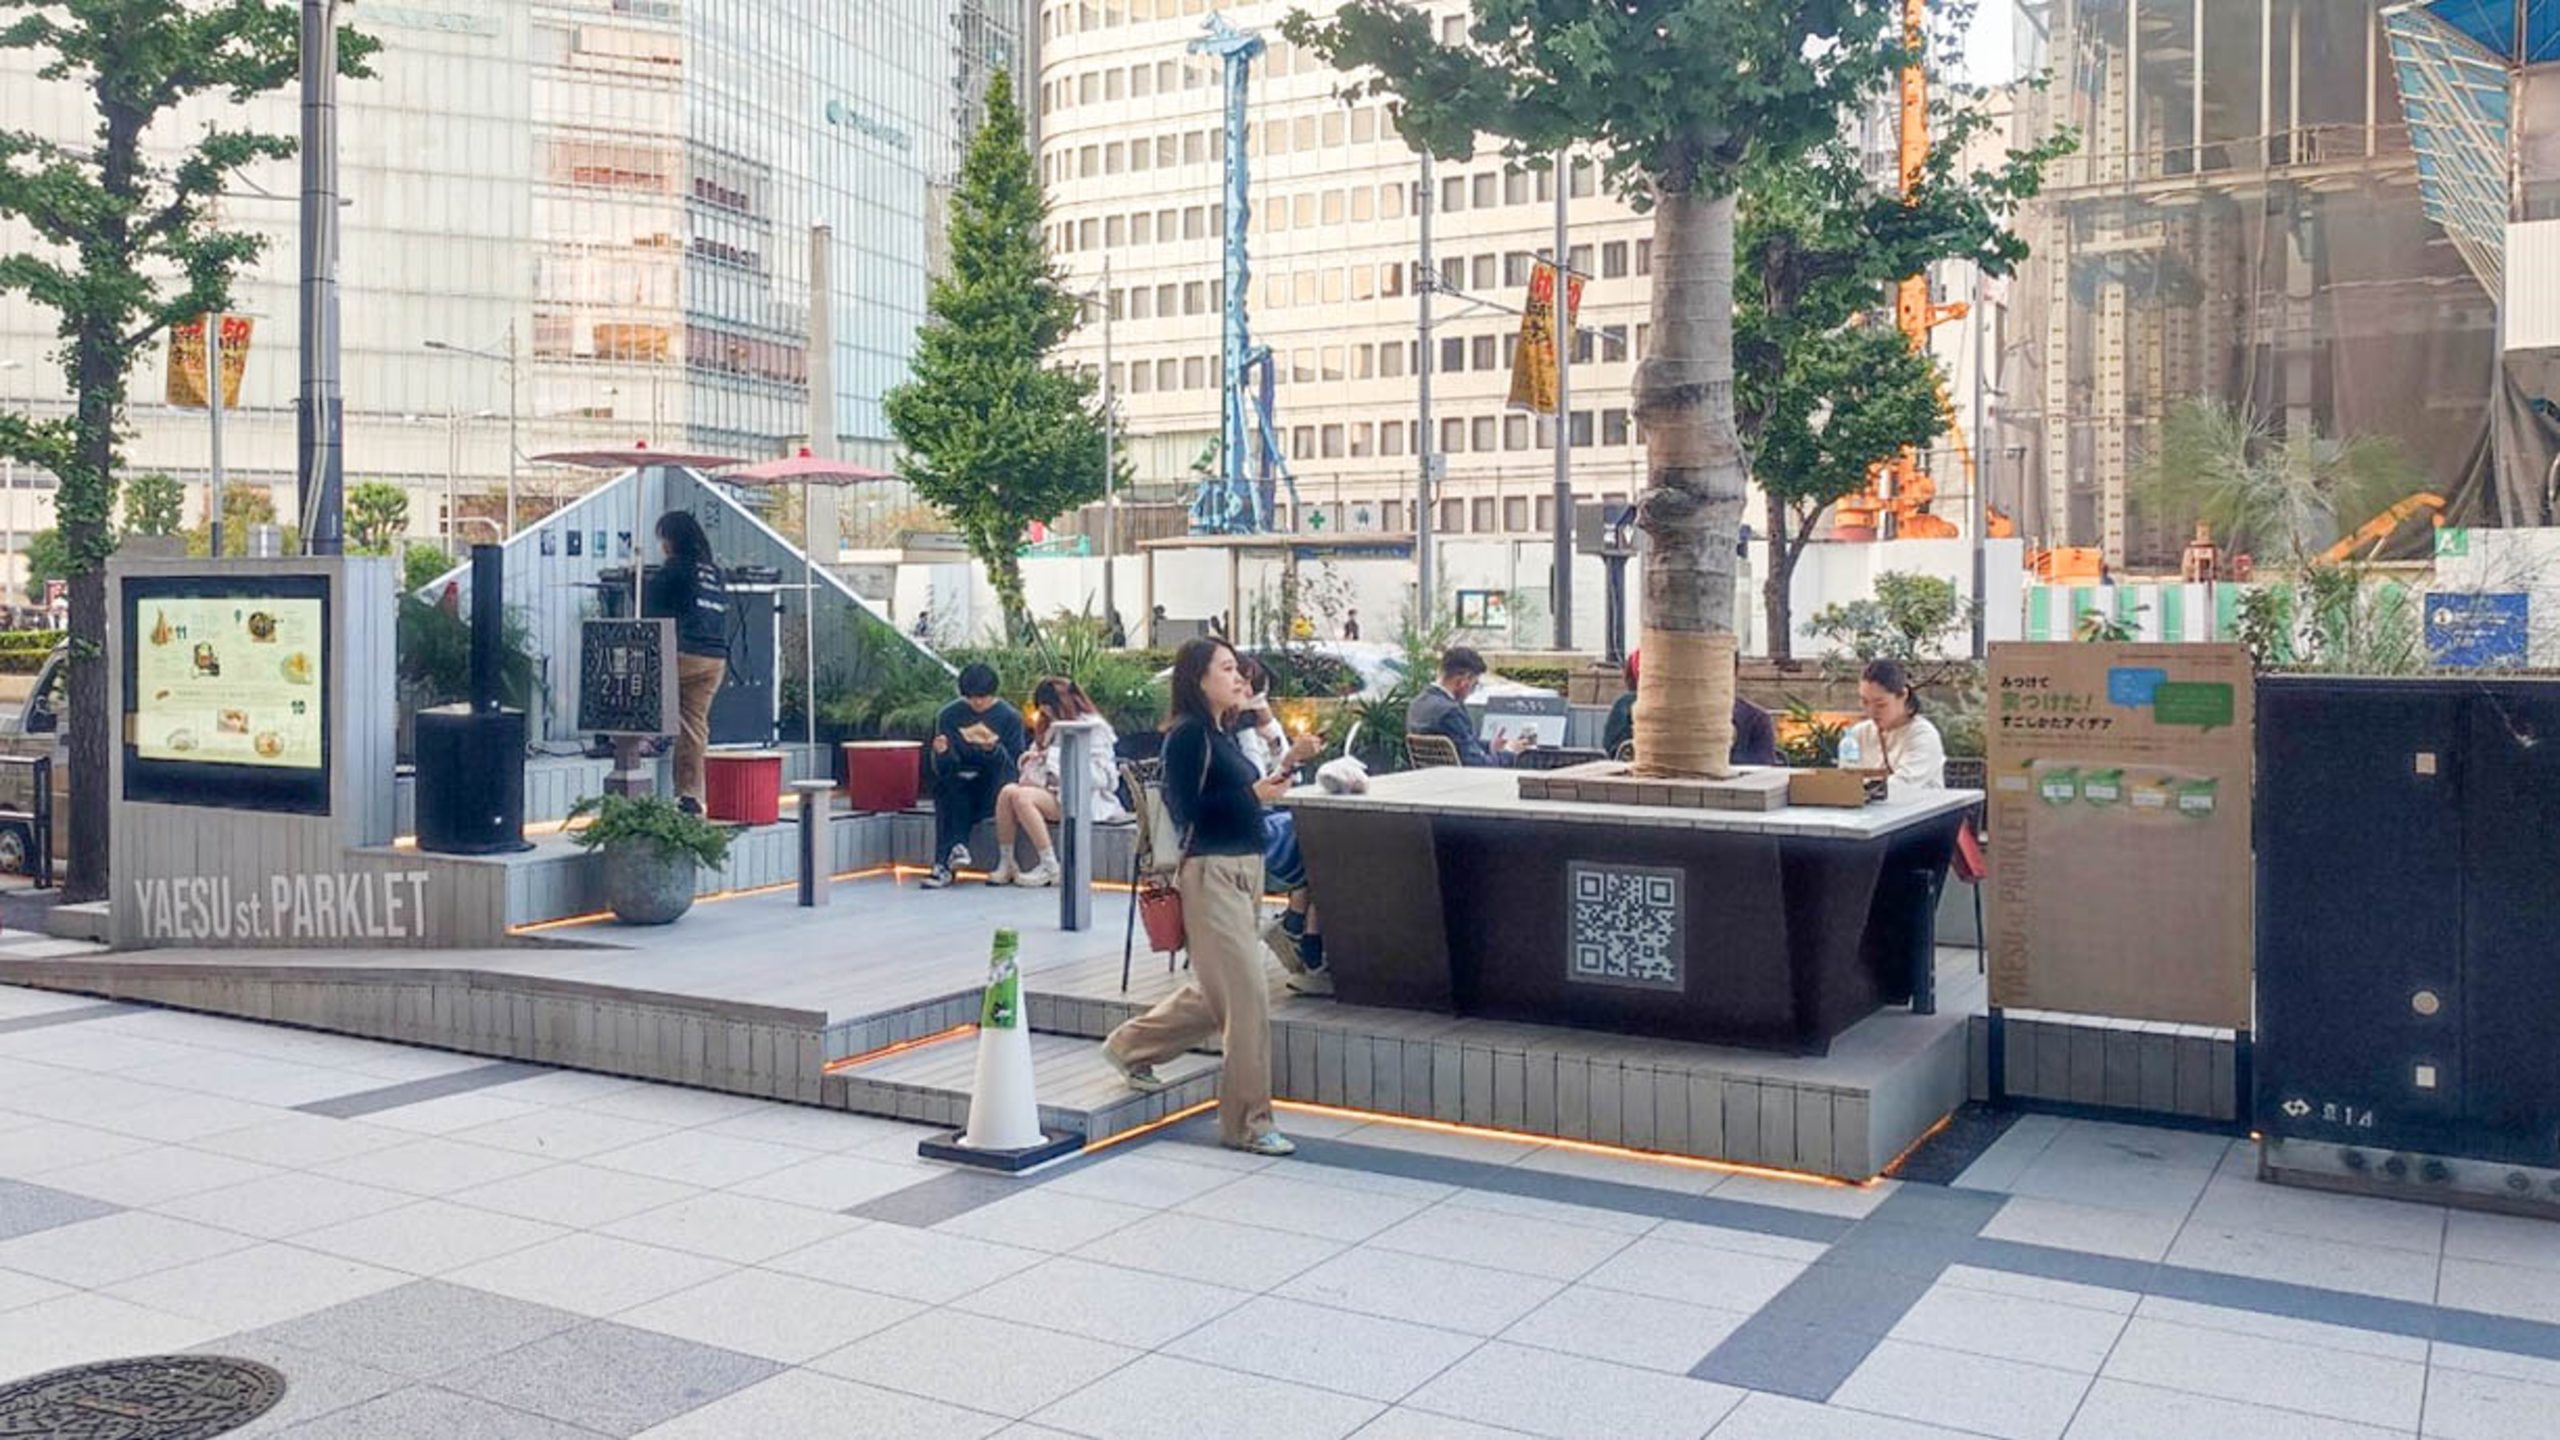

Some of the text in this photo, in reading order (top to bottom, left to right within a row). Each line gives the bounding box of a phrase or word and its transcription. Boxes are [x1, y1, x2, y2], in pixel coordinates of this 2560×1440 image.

[601, 674, 643, 696] 2丁目
[2001, 676, 2049, 688] みつけて
[2001, 803, 2027, 904] PARKLET
[135, 870, 429, 938] YAESU st. PARKLET
